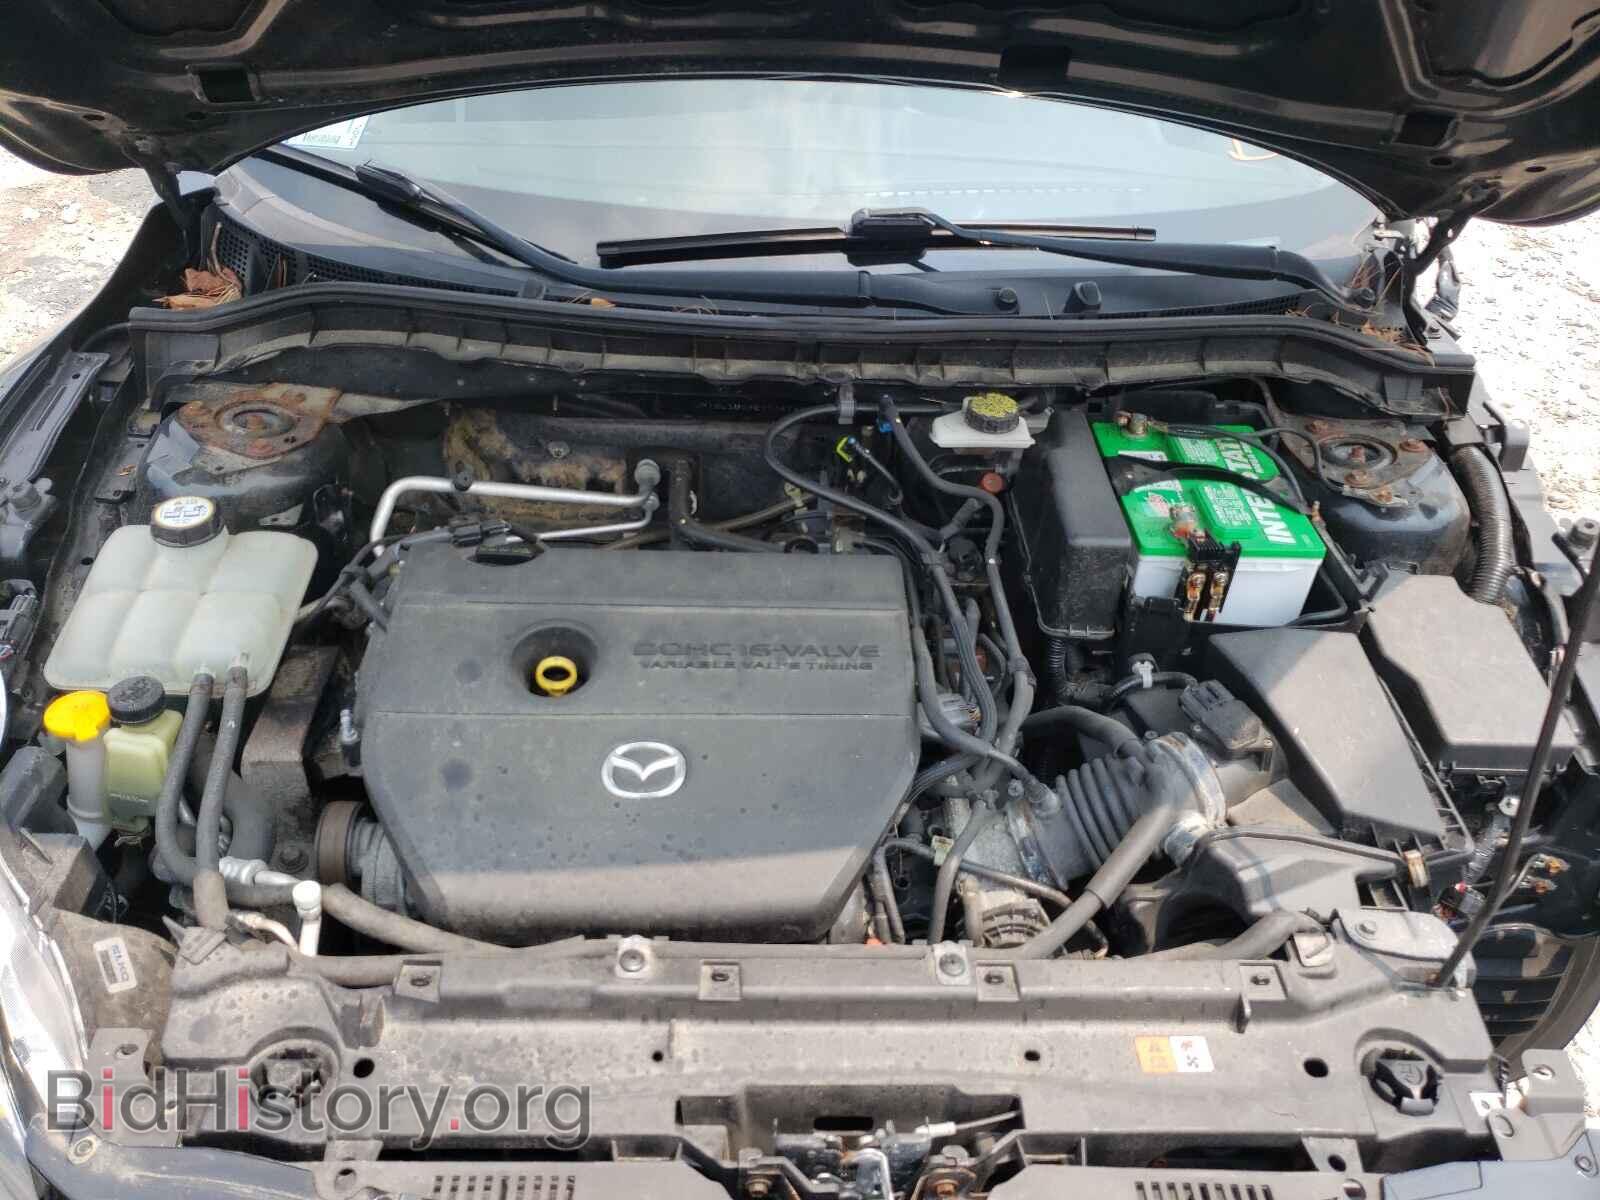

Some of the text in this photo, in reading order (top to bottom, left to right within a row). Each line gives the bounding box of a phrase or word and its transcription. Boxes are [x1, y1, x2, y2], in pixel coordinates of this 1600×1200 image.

[741, 644, 880, 658] 16-VALVE
[638, 660, 873, 671] VARIABLE VALVE TIMING
